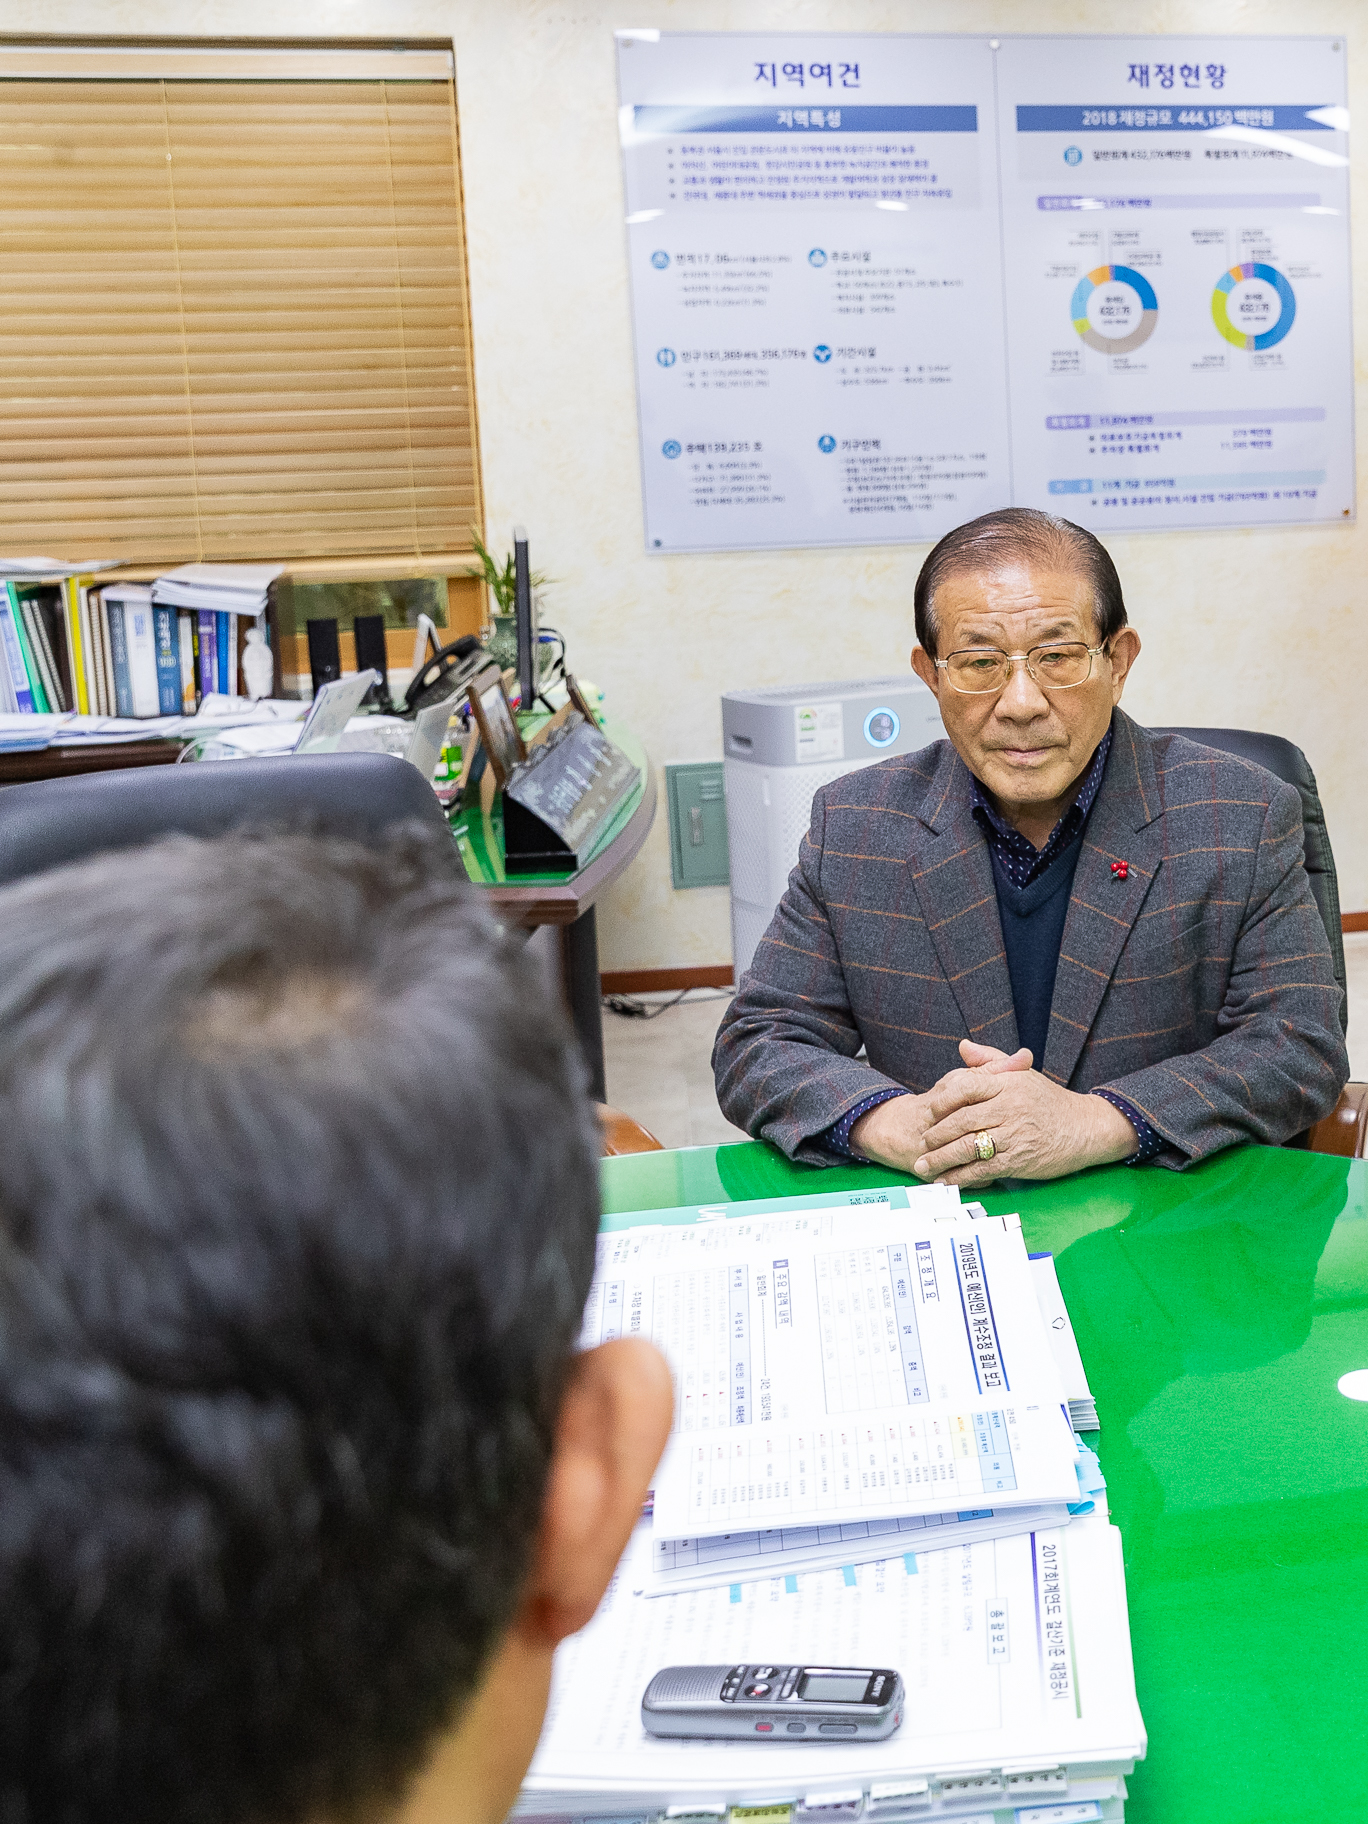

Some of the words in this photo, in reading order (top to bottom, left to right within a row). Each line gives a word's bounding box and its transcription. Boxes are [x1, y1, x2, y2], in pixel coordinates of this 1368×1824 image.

[754, 62, 862, 88] 지역여건
[1128, 62, 1227, 89] 재정현황
[777, 110, 842, 129] 지역특성
[1082, 109, 1117, 127] 2018
[1178, 109, 1234, 129] 444,150
[957, 1241, 980, 1280] 2019년도
[775, 1272, 787, 1288] 주요
[776, 1290, 788, 1306] 감액
[964, 1281, 987, 1315] 예산(안)
[777, 1309, 789, 1325] 내역
[971, 1316, 994, 1351] 계수조정
[978, 1352, 998, 1370] 결과
[982, 1371, 1002, 1388] 보고
[1039, 1542, 1063, 1616] 2017회계연도
[1044, 1618, 1066, 1658] 결산기준
[870, 1674, 886, 1698] SONY
[1047, 1659, 1070, 1701] 재정공시
